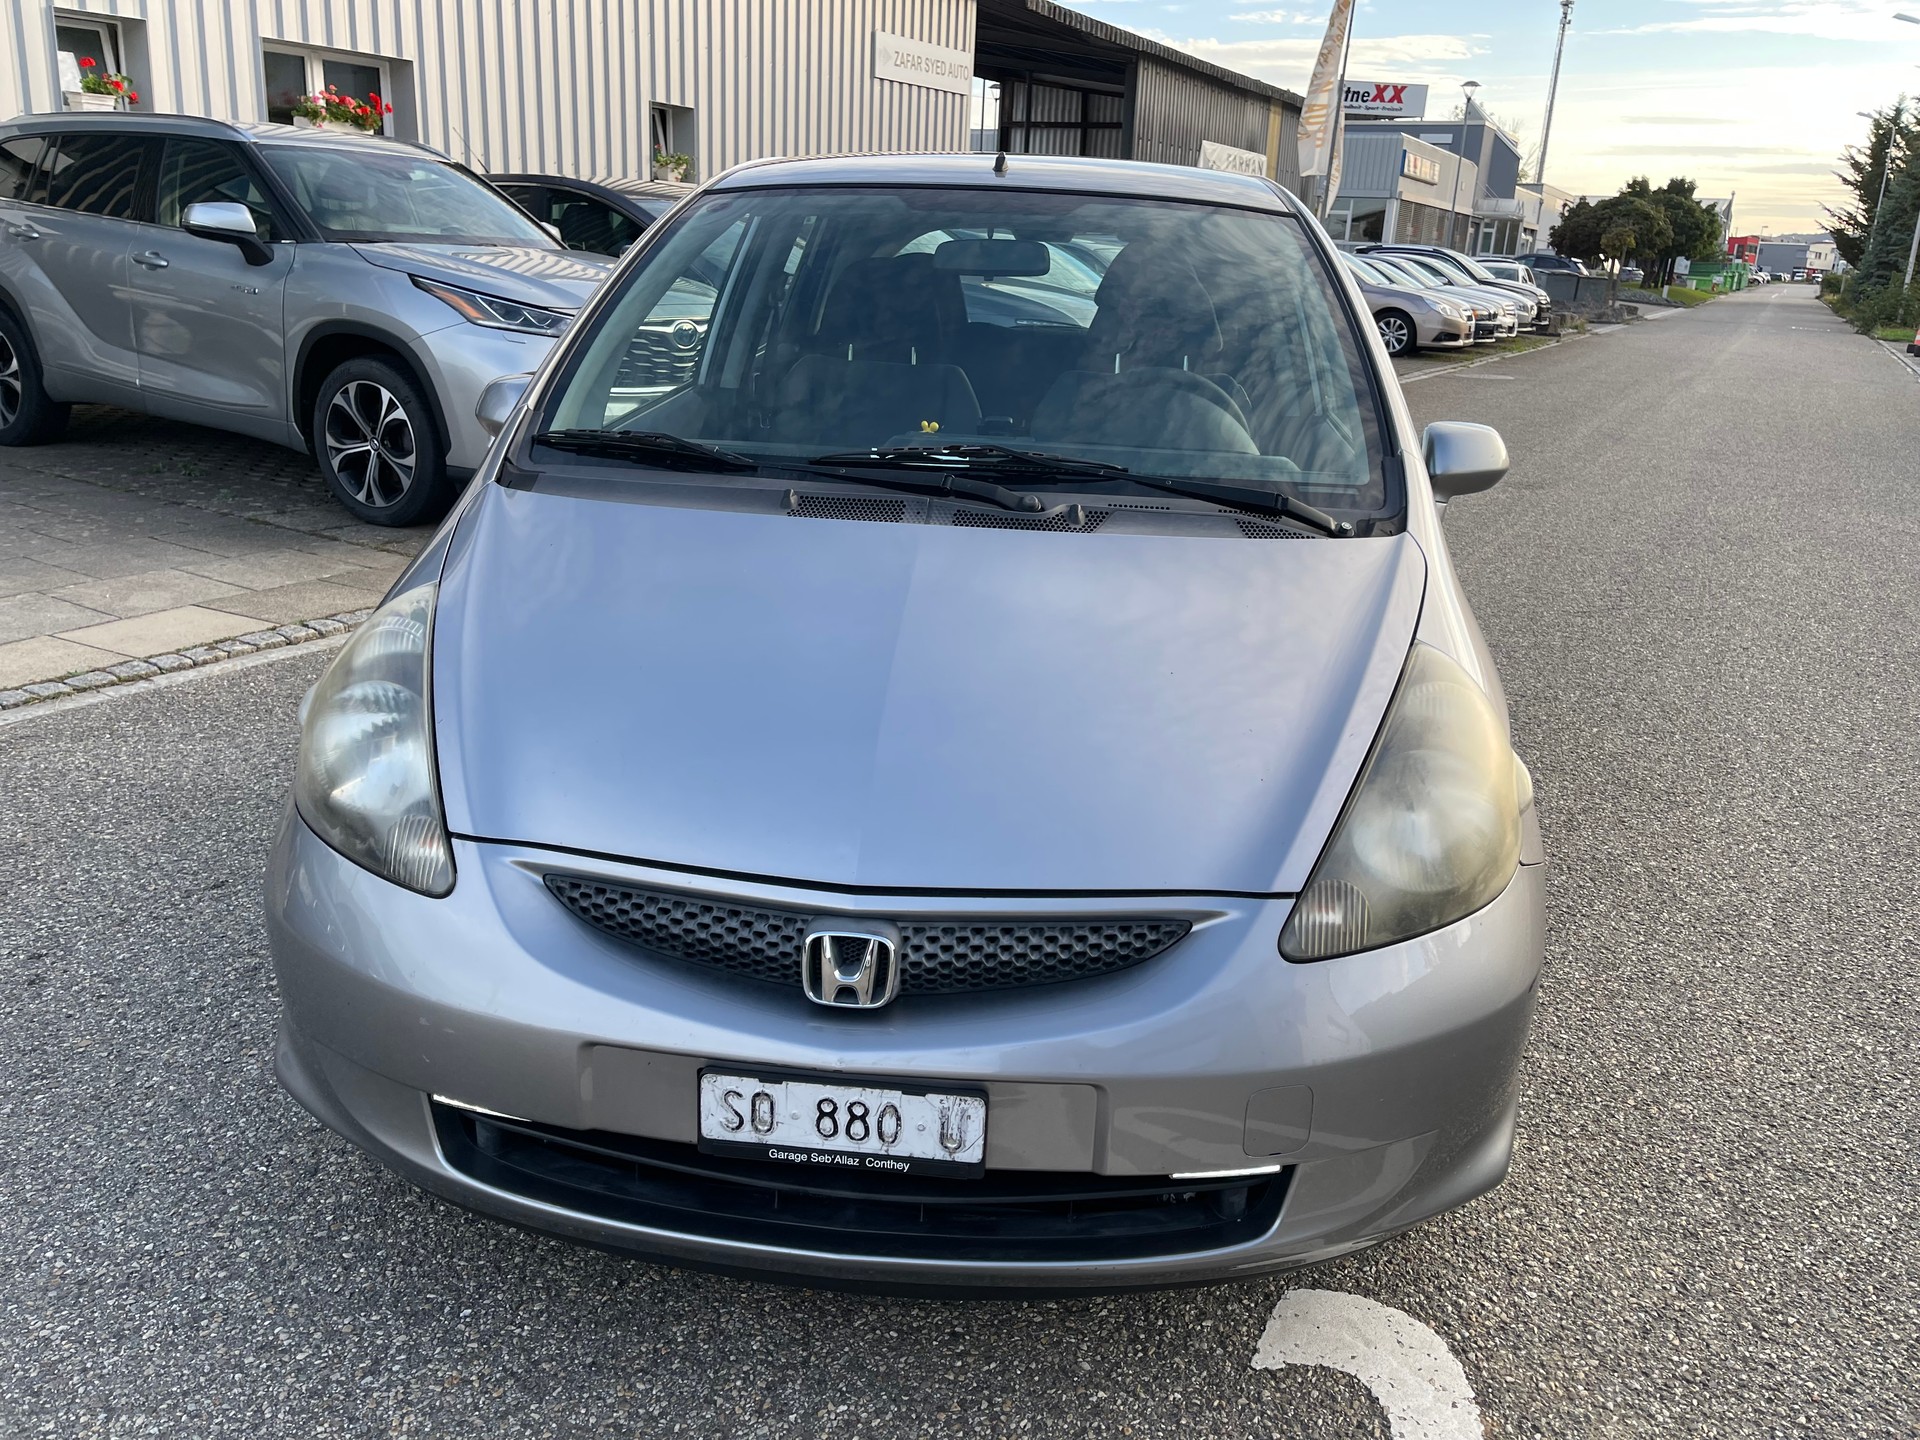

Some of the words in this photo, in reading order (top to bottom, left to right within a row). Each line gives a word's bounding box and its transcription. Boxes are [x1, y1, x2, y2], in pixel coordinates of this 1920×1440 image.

[894, 51, 923, 72] ZAFAR
[924, 57, 947, 76] SYED
[947, 62, 970, 81] AUTO
[1344, 84, 1408, 104] tneXX
[720, 1089, 776, 1135] SO
[815, 1096, 903, 1146] 880
[938, 1103, 967, 1153] U
[768, 1148, 808, 1163] Garage
[865, 1157, 910, 1172] Conthey
